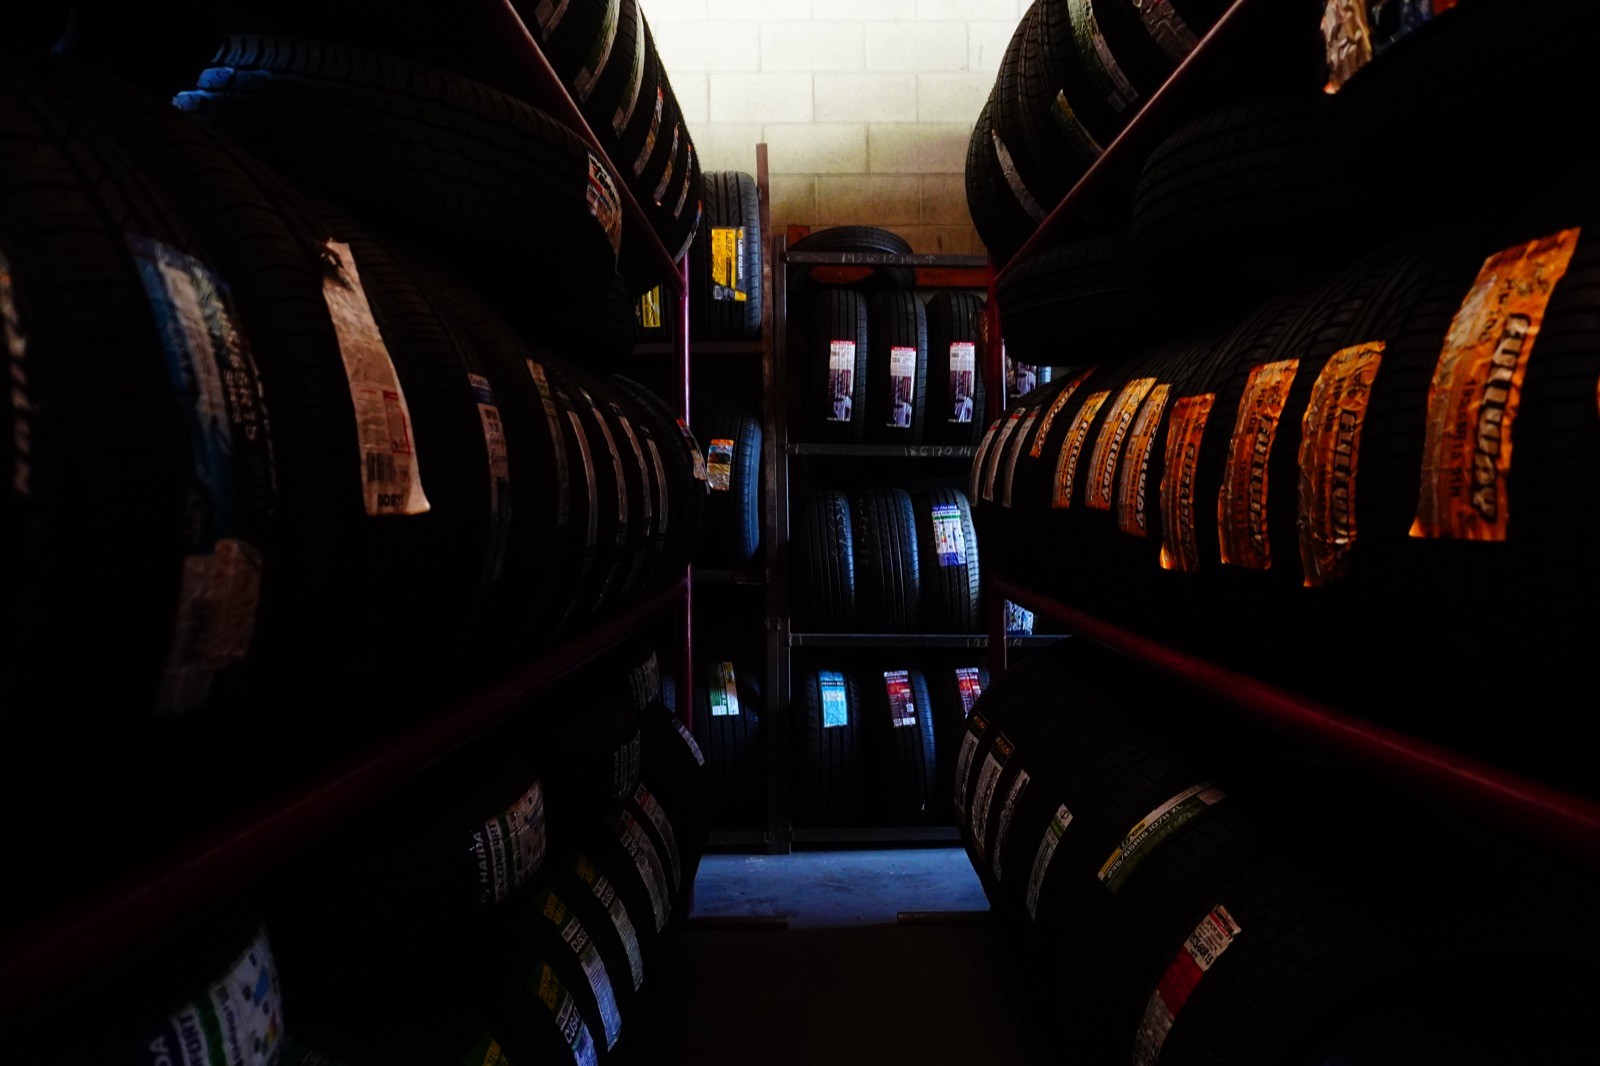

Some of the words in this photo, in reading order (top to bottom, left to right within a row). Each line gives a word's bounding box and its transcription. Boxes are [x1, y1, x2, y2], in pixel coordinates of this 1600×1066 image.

[1102, 412, 1130, 502] FULLWAY
[1472, 313, 1531, 522] FULLWAY
[473, 831, 489, 883] HAIDA
